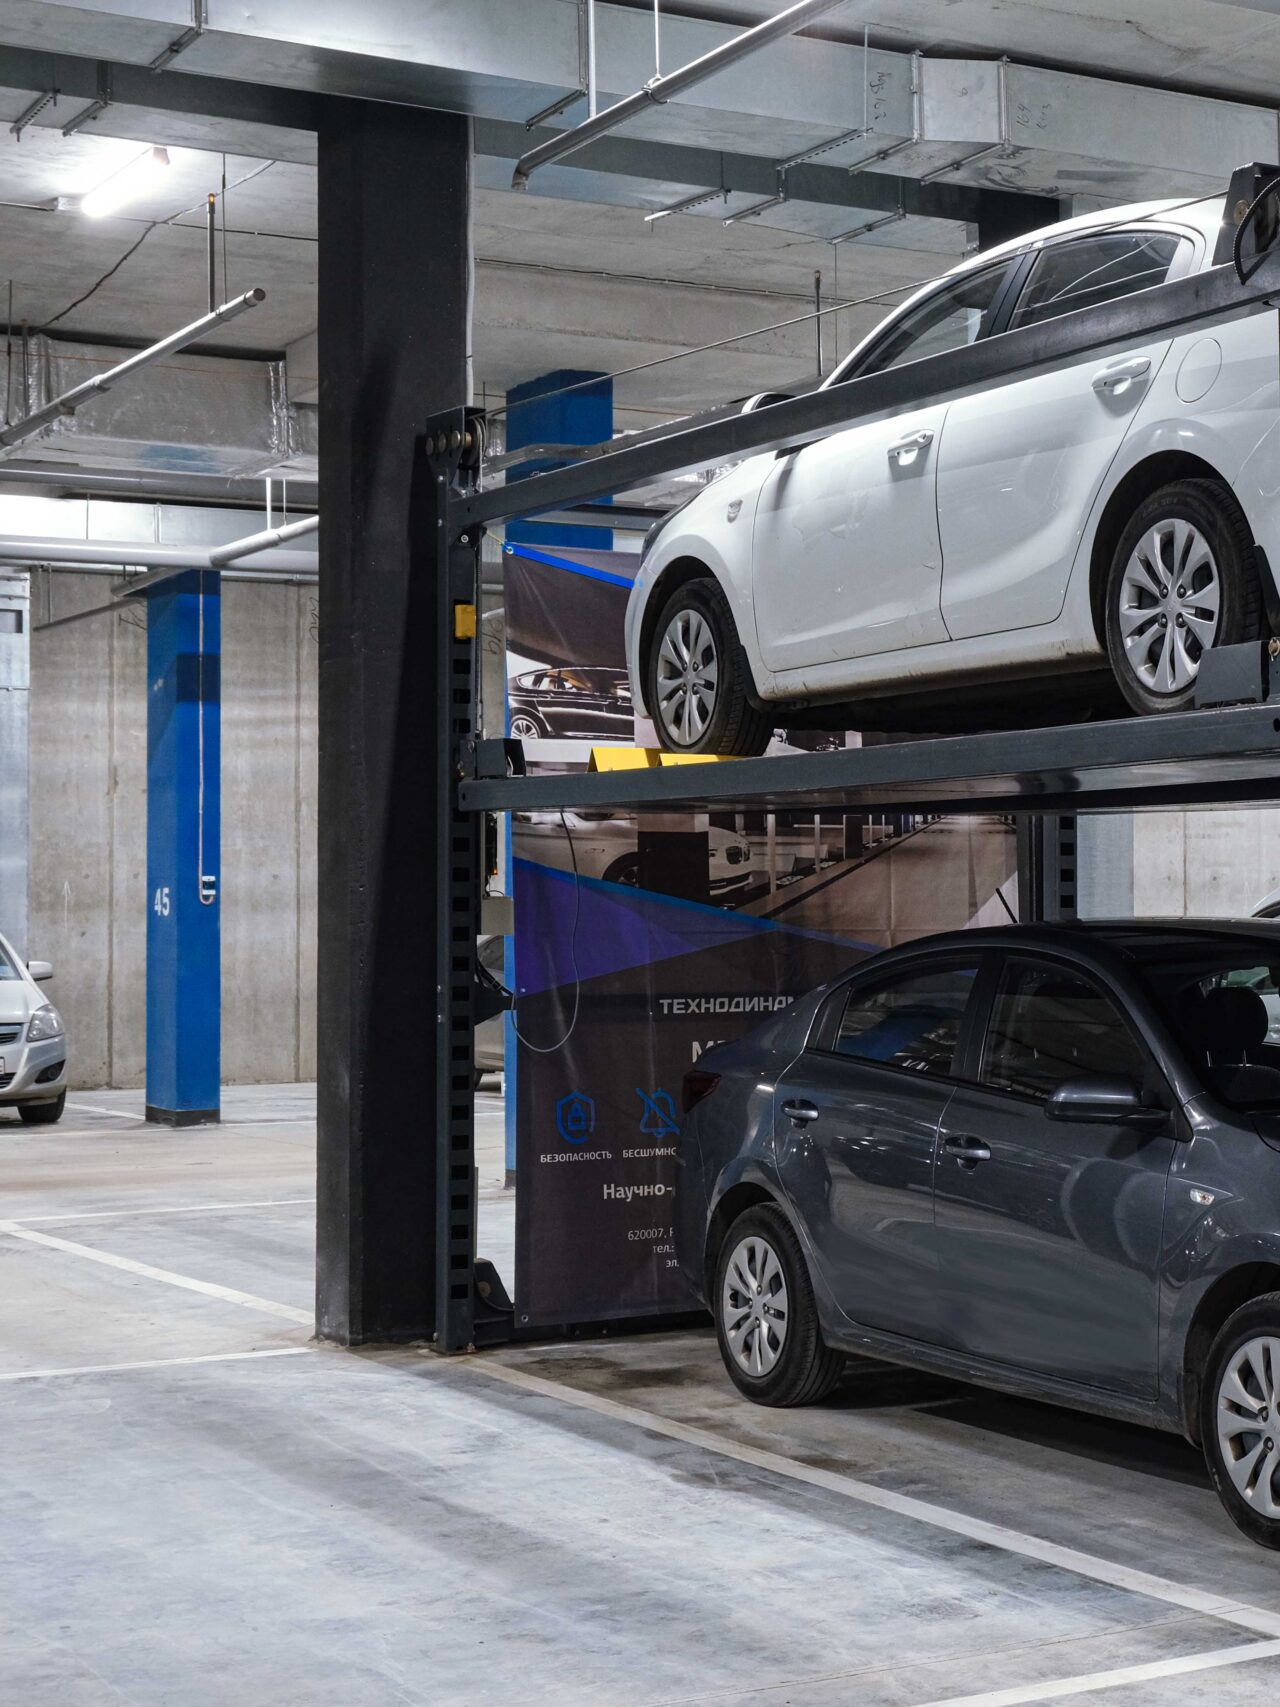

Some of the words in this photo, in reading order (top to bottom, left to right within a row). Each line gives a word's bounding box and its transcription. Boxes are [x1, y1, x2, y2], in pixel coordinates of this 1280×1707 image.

[154, 887, 170, 916] 45
[540, 1151, 612, 1163] БЕЗОПАСНОСТЬ
[603, 1183, 676, 1202] Научно-
[627, 1228, 667, 1240] 620007,
